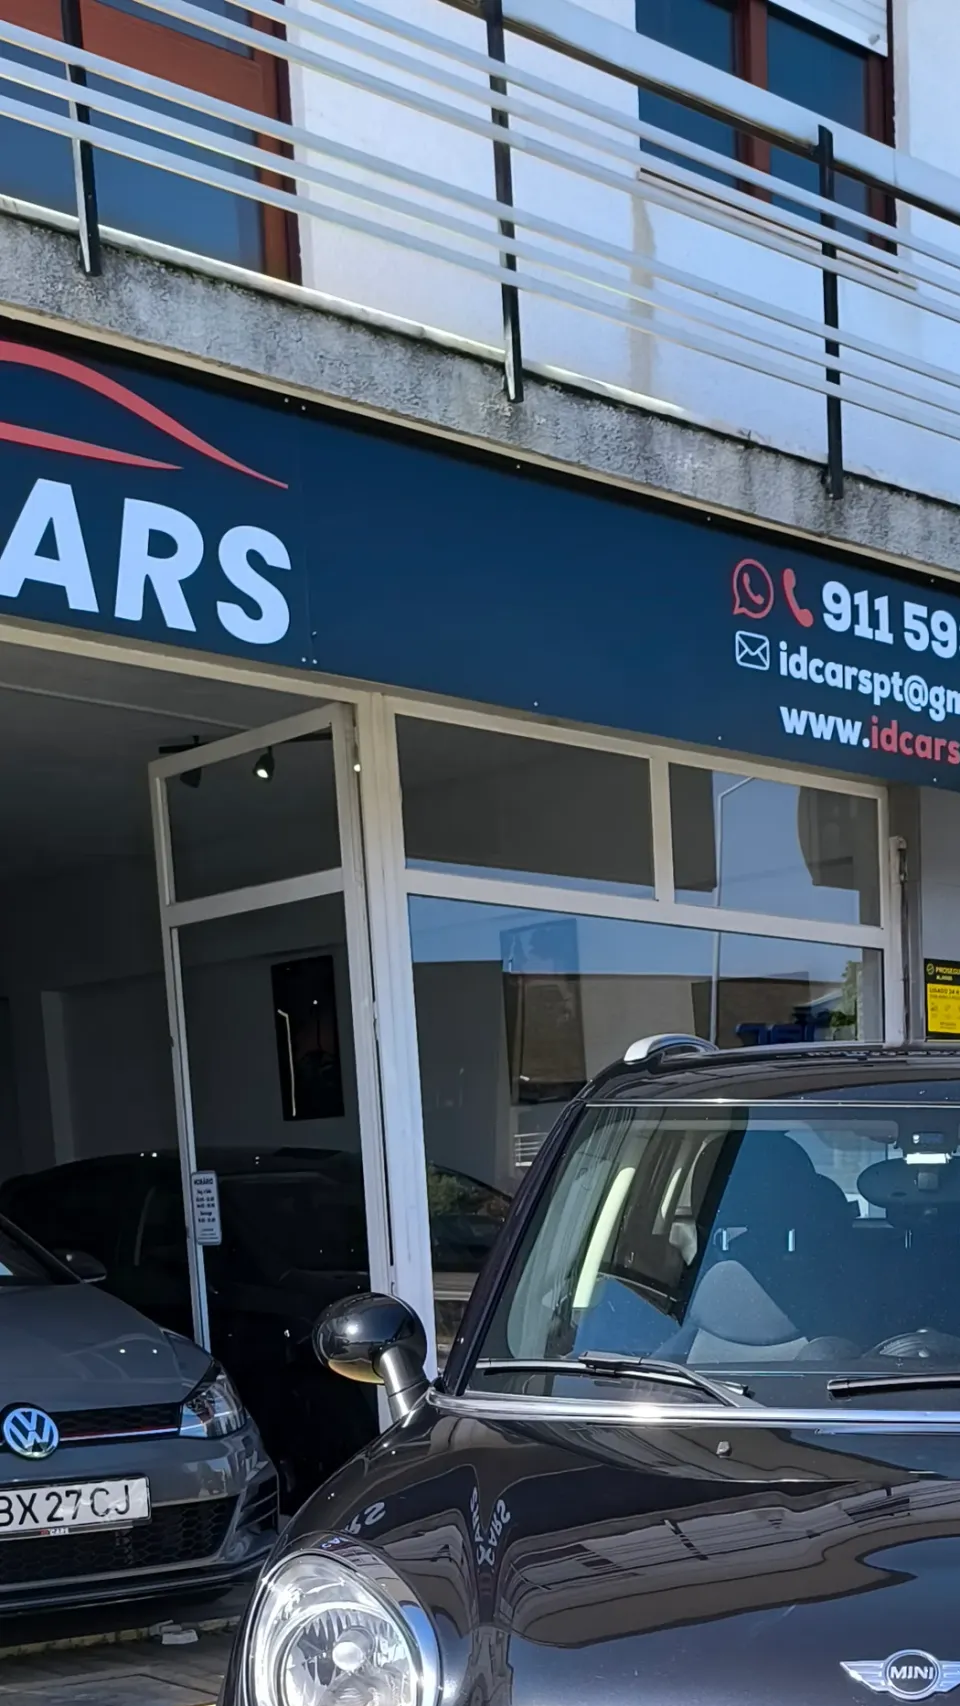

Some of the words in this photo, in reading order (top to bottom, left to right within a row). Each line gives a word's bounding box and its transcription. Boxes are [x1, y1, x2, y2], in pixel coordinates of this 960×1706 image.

[821, 581, 894, 645] 911
[0, 1493, 39, 1526] BX
[45, 1489, 82, 1522] 27
[90, 1485, 130, 1517] CJ
[890, 1666, 934, 1680] MINI
